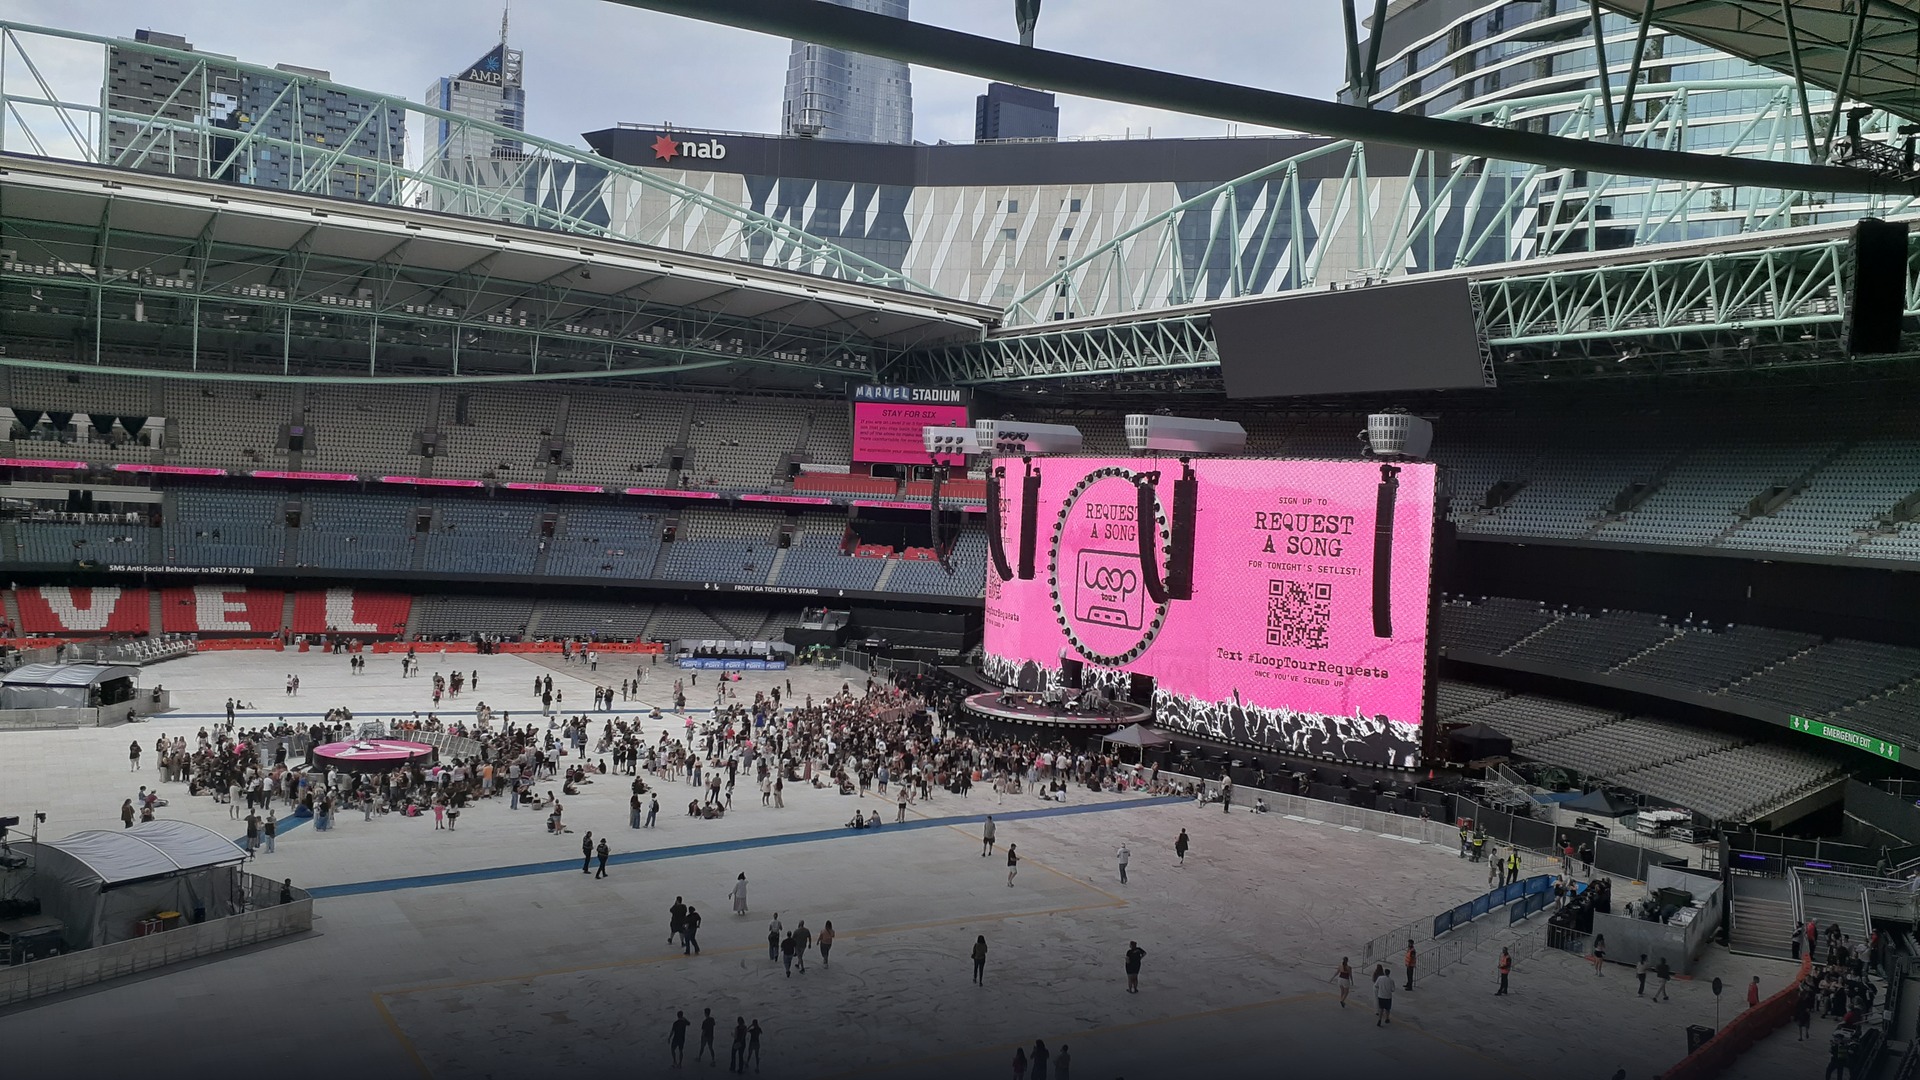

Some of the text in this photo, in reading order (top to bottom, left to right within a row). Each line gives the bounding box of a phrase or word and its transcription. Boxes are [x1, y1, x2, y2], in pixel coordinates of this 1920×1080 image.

[469, 68, 501, 84] AMP
[682, 139, 726, 160] nab
[856, 386, 960, 402] MARVEL STADIUM
[882, 409, 937, 419] STAY FOR SIX
[1278, 497, 1328, 506] SIGN UP TO
[1090, 523, 1136, 541] A SONG
[1254, 511, 1354, 535] REQUEST
[1262, 535, 1344, 557] A SONG
[1248, 560, 1362, 576] FOR TONIGHT'S SETLIST!
[1101, 592, 1117, 602] tour
[1216, 647, 1389, 680] Text #LoopTourRequests
[1254, 670, 1344, 688] ONCE YOU'VE SIGNED UP
[1823, 726, 1872, 748] EMERGENCY EXIT
